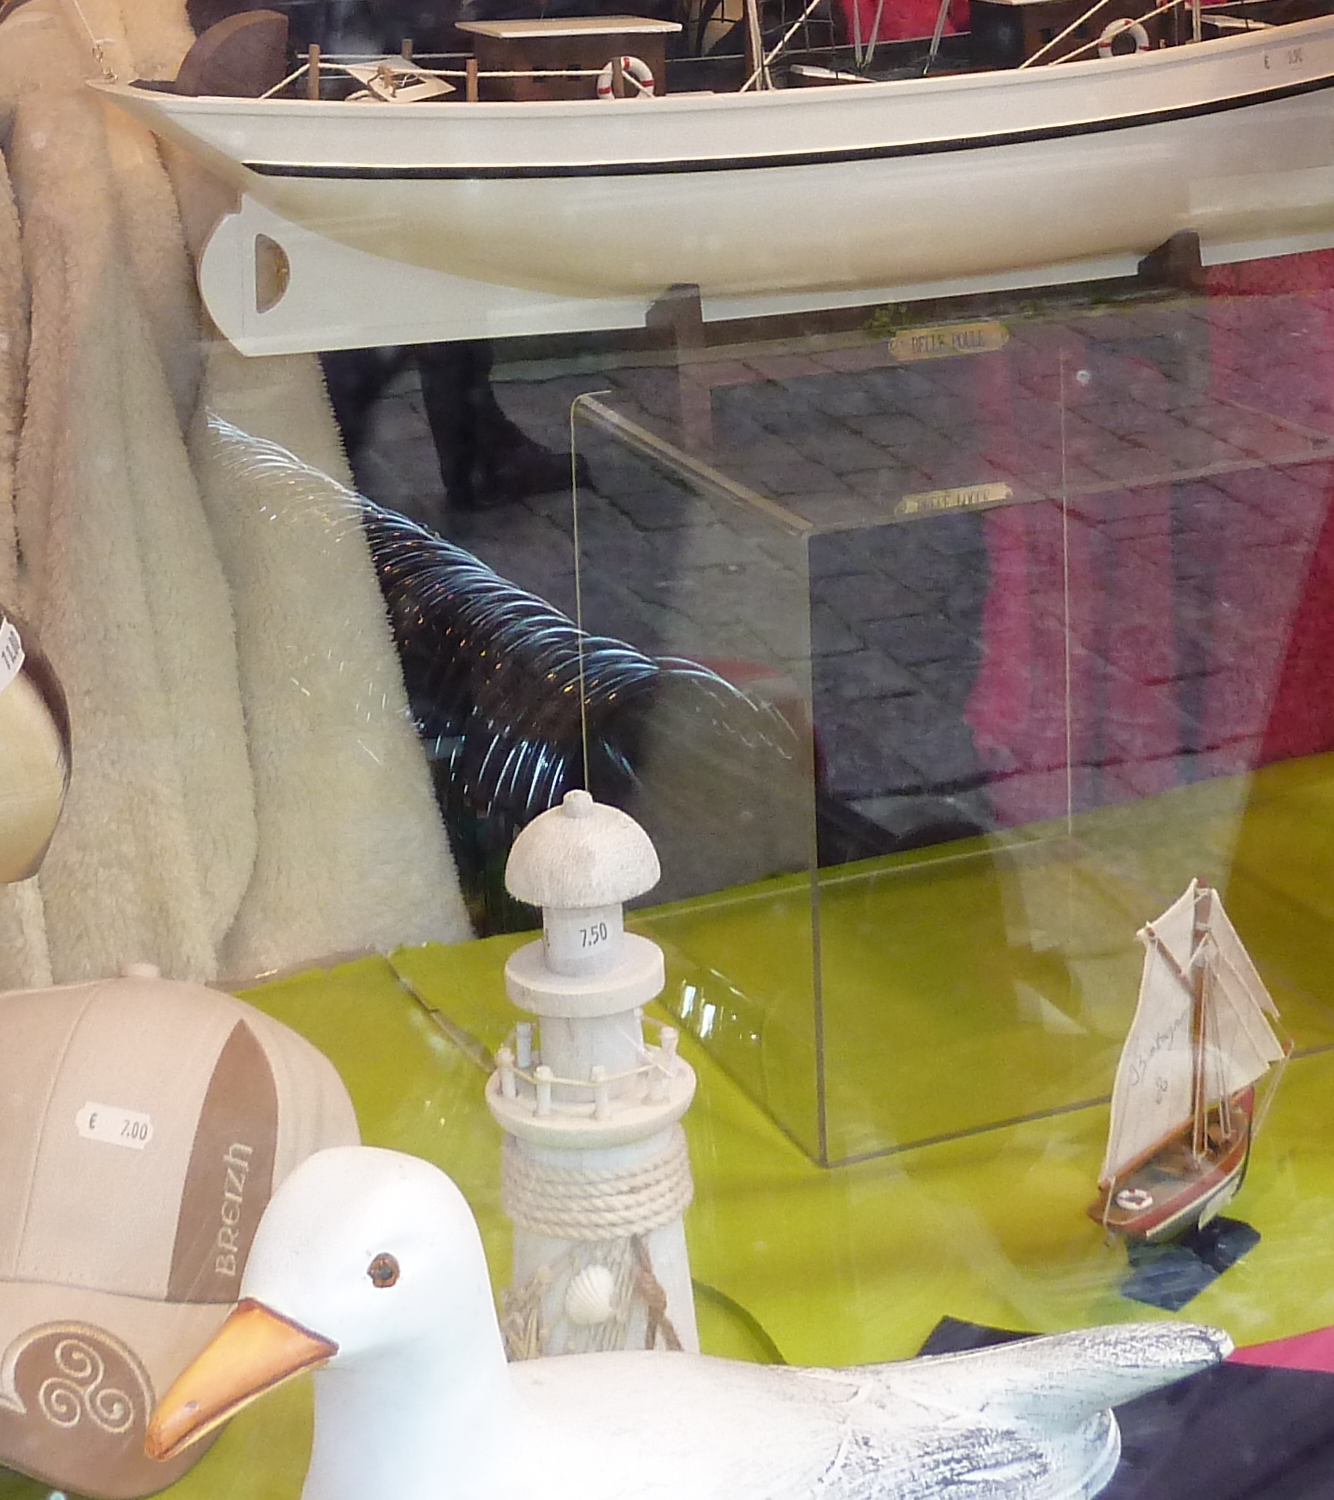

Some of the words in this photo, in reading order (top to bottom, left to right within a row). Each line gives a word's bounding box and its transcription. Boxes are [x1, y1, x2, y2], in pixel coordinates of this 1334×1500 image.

[579, 922, 608, 948] 7.50
[89, 1112, 98, 1130] €
[120, 1119, 148, 1141] 7.00
